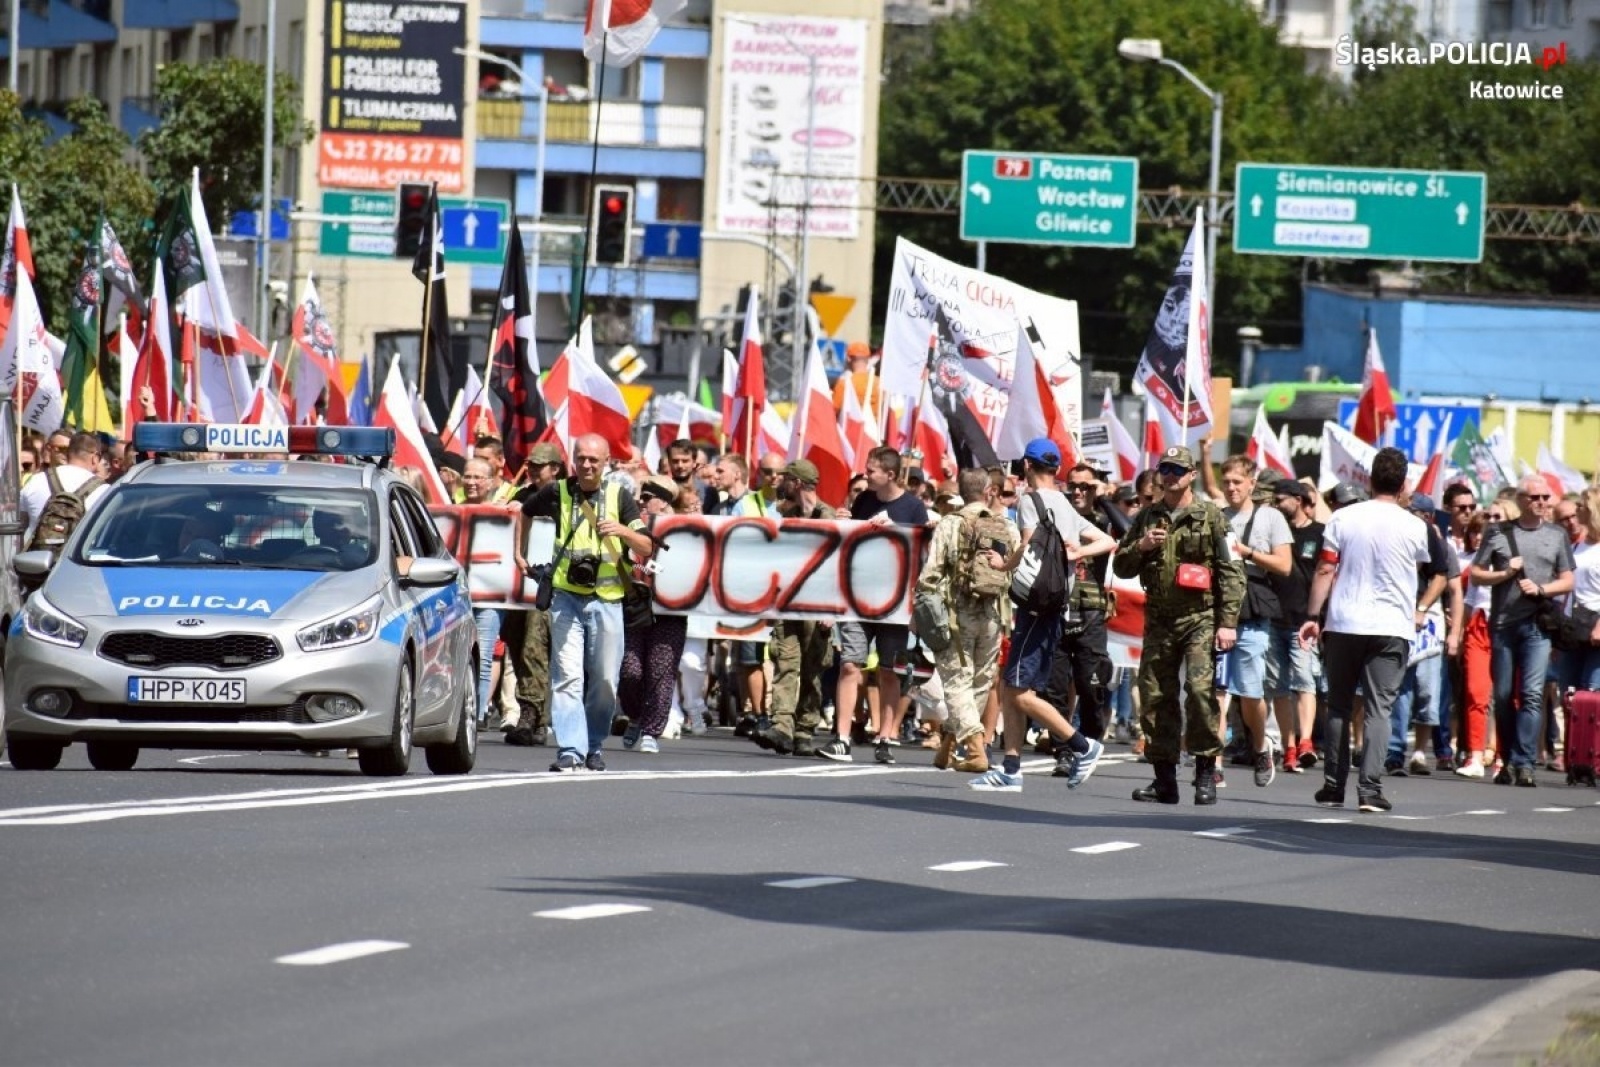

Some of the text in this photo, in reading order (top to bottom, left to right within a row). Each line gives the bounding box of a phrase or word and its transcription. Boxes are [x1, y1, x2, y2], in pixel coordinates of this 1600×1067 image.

[344, 55, 438, 77] POLISH FOR
[343, 139, 461, 165] 32 726 27 78
[1004, 159, 1113, 183] 79 Poznań
[1276, 171, 1451, 198] Siemianowice Śl.
[1037, 186, 1127, 209] Wrocław
[1035, 211, 1113, 235] Gliwice
[904, 252, 1017, 315] TRWA CICHA
[914, 287, 961, 314] WONA
[208, 427, 286, 447] POLICJA
[119, 595, 272, 613] POLICJA
[142, 680, 241, 700] HPP K045
